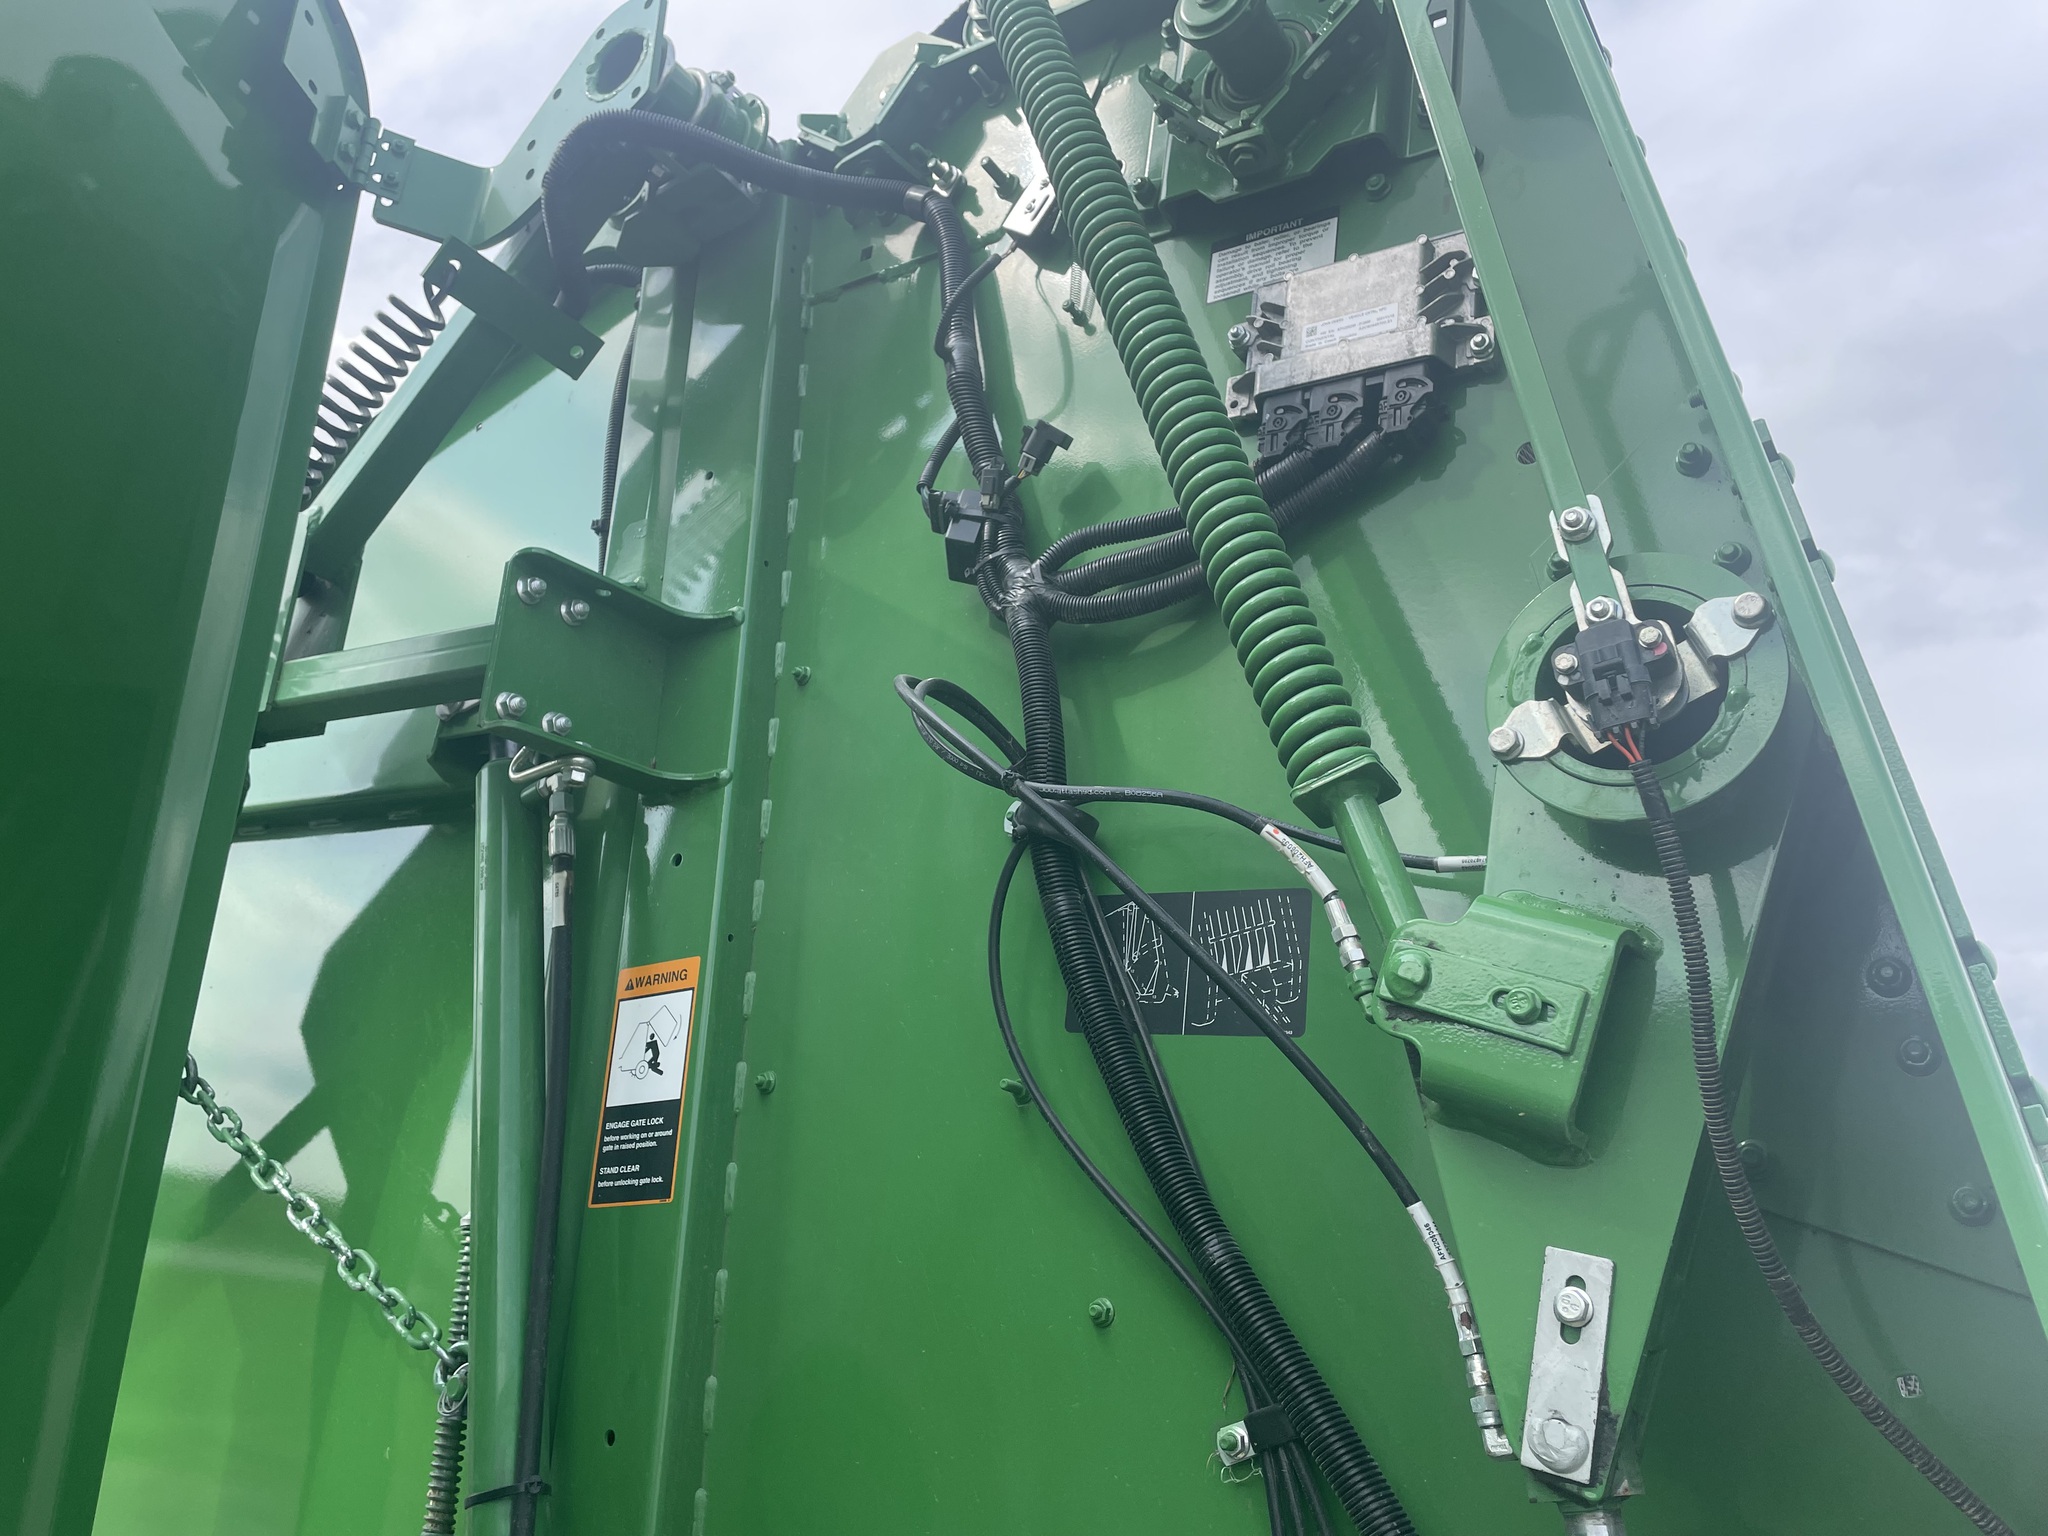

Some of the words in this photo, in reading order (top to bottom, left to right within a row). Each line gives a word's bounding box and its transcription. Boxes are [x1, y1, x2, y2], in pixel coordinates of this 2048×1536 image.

[1245, 218, 1304, 241] IMPORTANT
[1218, 247, 1242, 258] Damage
[1304, 222, 1331, 232] bearings
[1268, 237, 1296, 248] improper
[1299, 230, 1320, 239] torque
[1217, 256, 1249, 268] installation
[1300, 234, 1324, 245] prevent
[1248, 260, 1271, 268] manual
[1285, 250, 1306, 259] proper
[1217, 264, 1235, 273] failure
[1276, 248, 1290, 256] refer
[1265, 262, 1276, 270] roll
[1278, 256, 1302, 266] bearing
[1266, 262, 1298, 274] tightening
[635, 968, 688, 988] WARNING
[605, 1120, 630, 1130] ENGAGE
[630, 1118, 646, 1128] GATE
[648, 1116, 664, 1125] LOCK
[620, 1132, 640, 1140] working
[654, 1129, 673, 1137] around
[602, 1145, 614, 1153] gate
[620, 1142, 636, 1150] raised
[636, 1140, 658, 1150] position.
[599, 1166, 619, 1174] STAND
[620, 1164, 640, 1173] CLEAR
[598, 1180, 614, 1188] before
[614, 1178, 638, 1186] unlocking
[639, 1178, 650, 1186] gate
